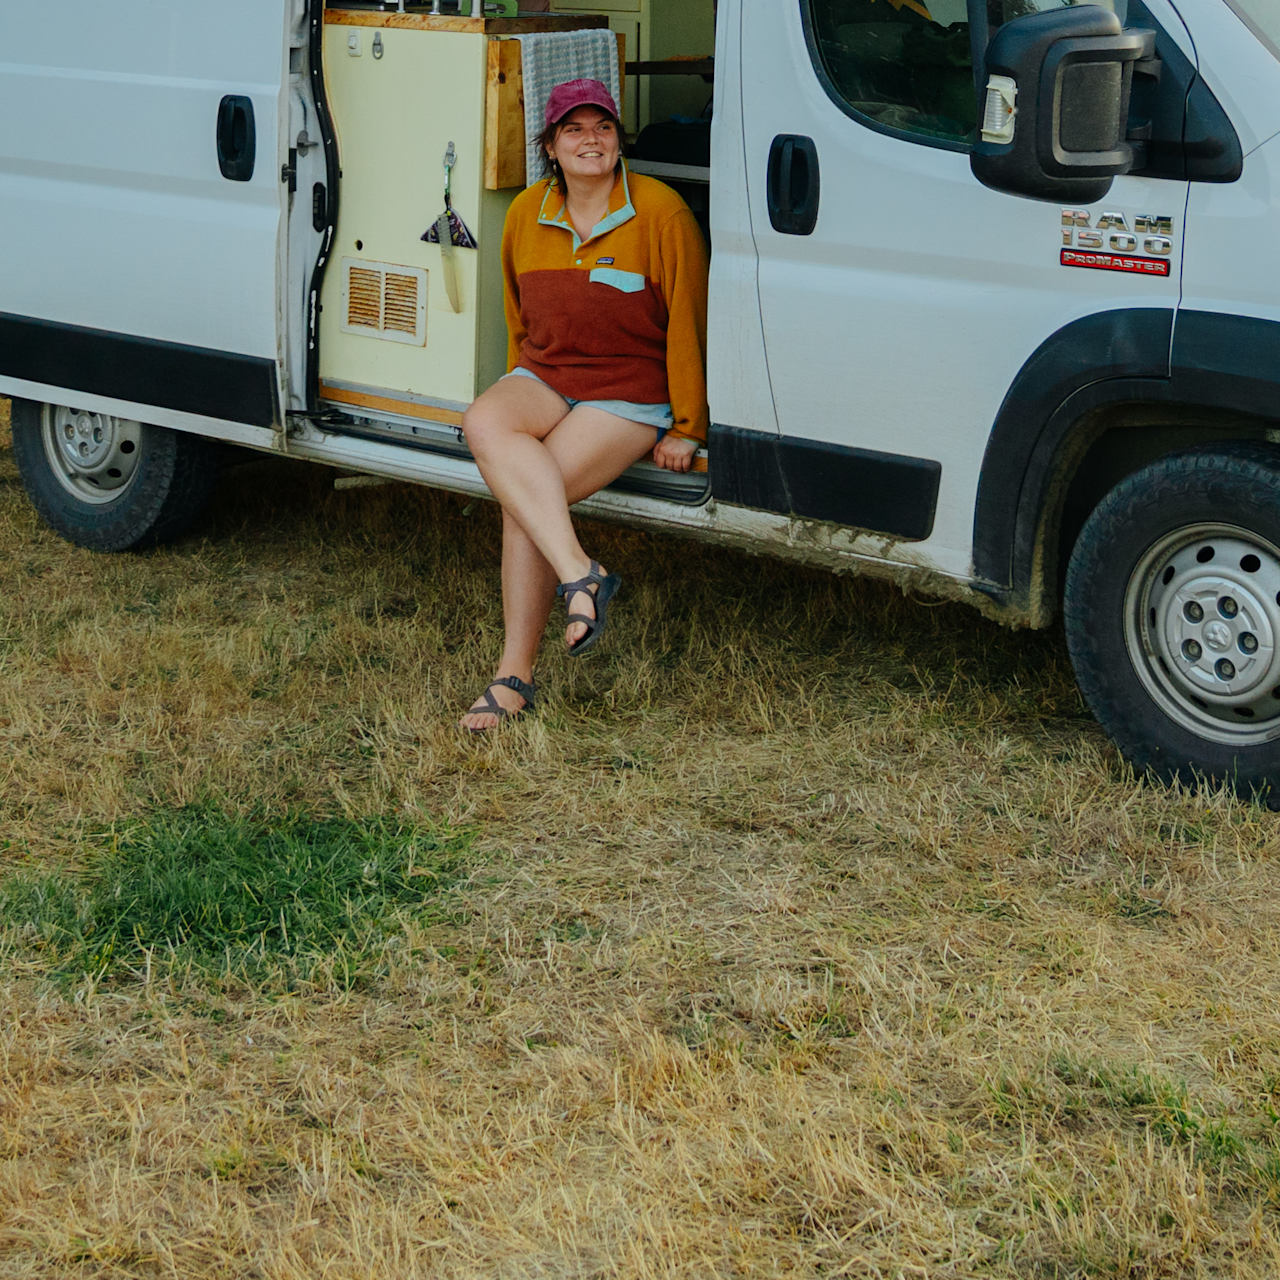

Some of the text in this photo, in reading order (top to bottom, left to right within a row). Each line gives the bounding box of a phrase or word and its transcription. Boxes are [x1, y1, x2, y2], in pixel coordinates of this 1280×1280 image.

[1060, 207, 1174, 235] RAM
[1060, 229, 1172, 255] 1500
[1063, 252, 1166, 272] PROMASTER
